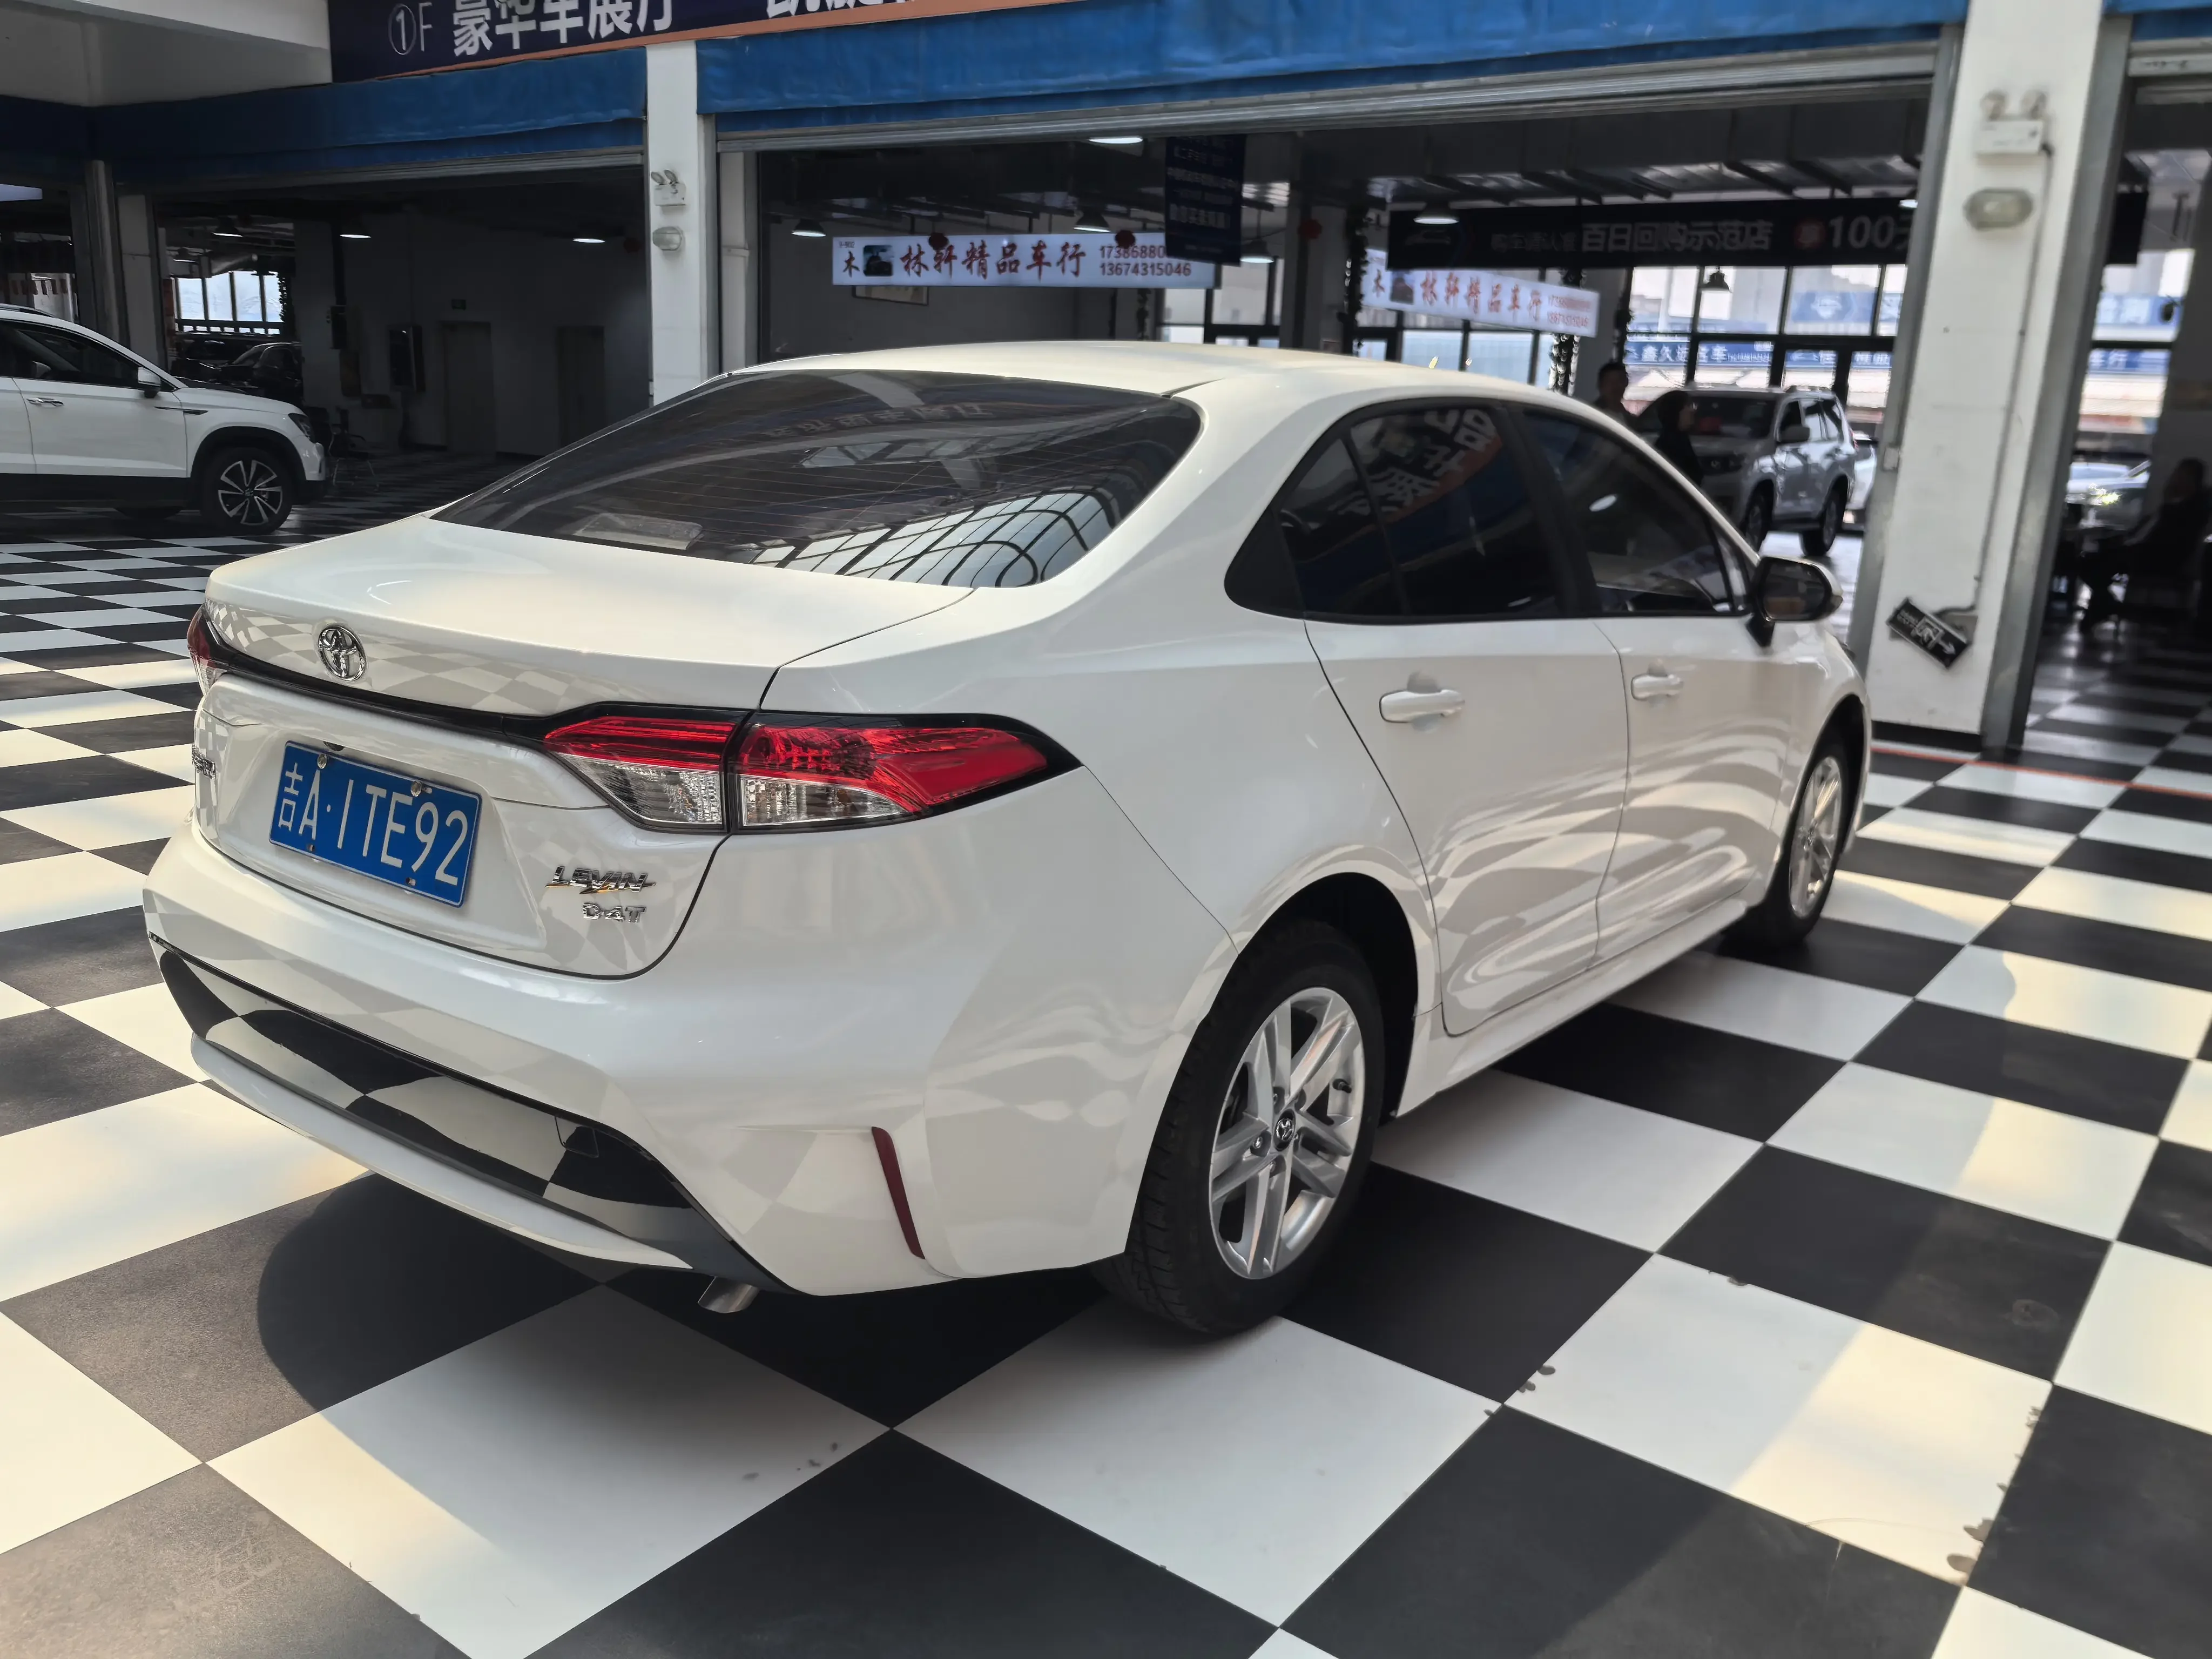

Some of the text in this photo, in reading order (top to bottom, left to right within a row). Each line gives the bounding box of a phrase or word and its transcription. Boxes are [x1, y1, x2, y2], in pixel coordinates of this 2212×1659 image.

[900, 240, 1086, 282] 林轩精品车行
[1100, 263, 1191, 276] 13674315046
[552, 866, 648, 892] LEVIN
